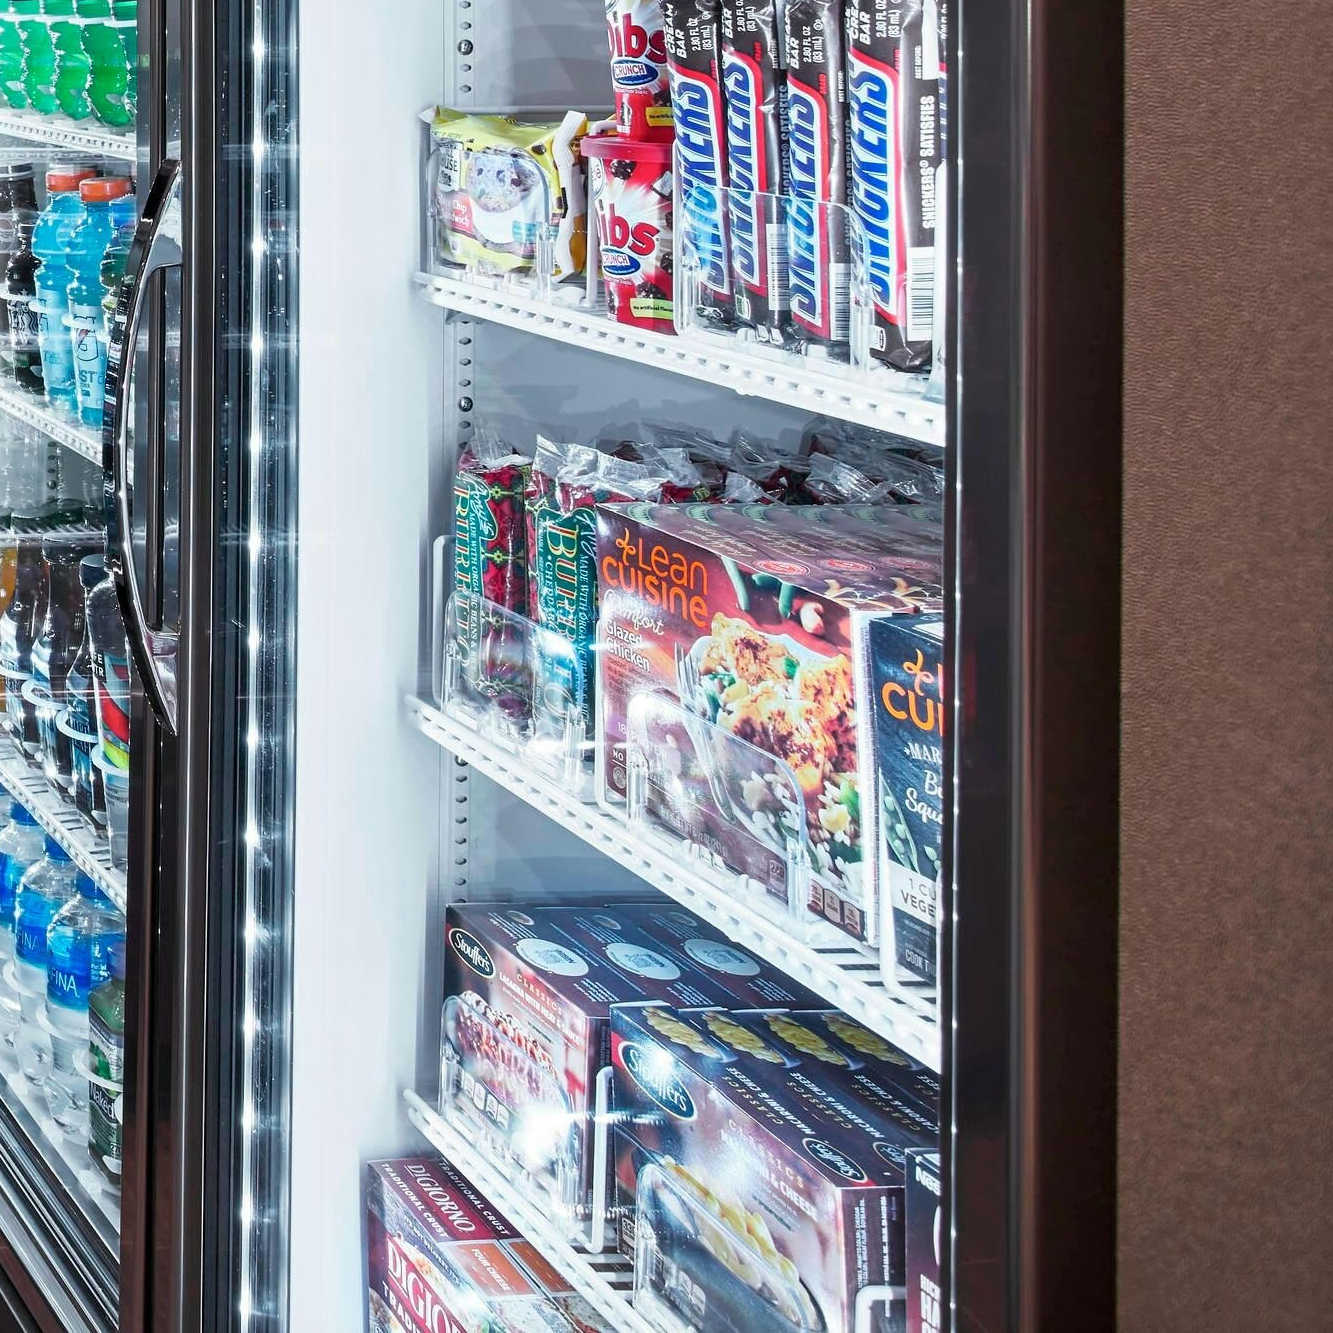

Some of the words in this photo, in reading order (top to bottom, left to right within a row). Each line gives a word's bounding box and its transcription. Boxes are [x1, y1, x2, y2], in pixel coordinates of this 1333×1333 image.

[665, 3, 676, 54] CREAM
[676, 28, 687, 59] BAR
[722, 9, 733, 39] BAR
[859, 11, 871, 46] BAR
[876, 23, 887, 38] 2.80
[613, 63, 645, 77] CRUNCH
[790, 37, 800, 70] BAR
[919, 94, 935, 157] SATISFIES
[788, 90, 821, 323] SNICKERS
[851, 68, 895, 312] SNICKERS
[471, 483, 496, 538] Amy's
[454, 485, 472, 667] BURRITO
[638, 537, 709, 596] Lean
[605, 619, 644, 648] Glazed
[606, 636, 651, 672] Chicken
[612, 748, 624, 762] NO
[455, 932, 491, 973] Stouffer's
[725, 1066, 761, 1092] CHEESE
[789, 1071, 825, 1097] CHEESE
[853, 1073, 891, 1099] CHEESE
[89, 1085, 116, 1121] Naked
[722, 1075, 784, 1126] CLASSICS
[765, 1098, 816, 1136] MACARONI
[786, 1081, 853, 1130] CLASSICS
[833, 1100, 885, 1139] MACARONI
[381, 1163, 425, 1212] TRADITIONAL
[423, 1212, 450, 1239] CRUST
[404, 1164, 476, 1234] DIGIORNO
[438, 1157, 486, 1211] TRADITIONAL
[483, 1209, 510, 1236] CRUST
[779, 1179, 819, 1222] CHEESE
[472, 1248, 490, 1267] FOUR
[487, 1265, 514, 1292] CHEESE
